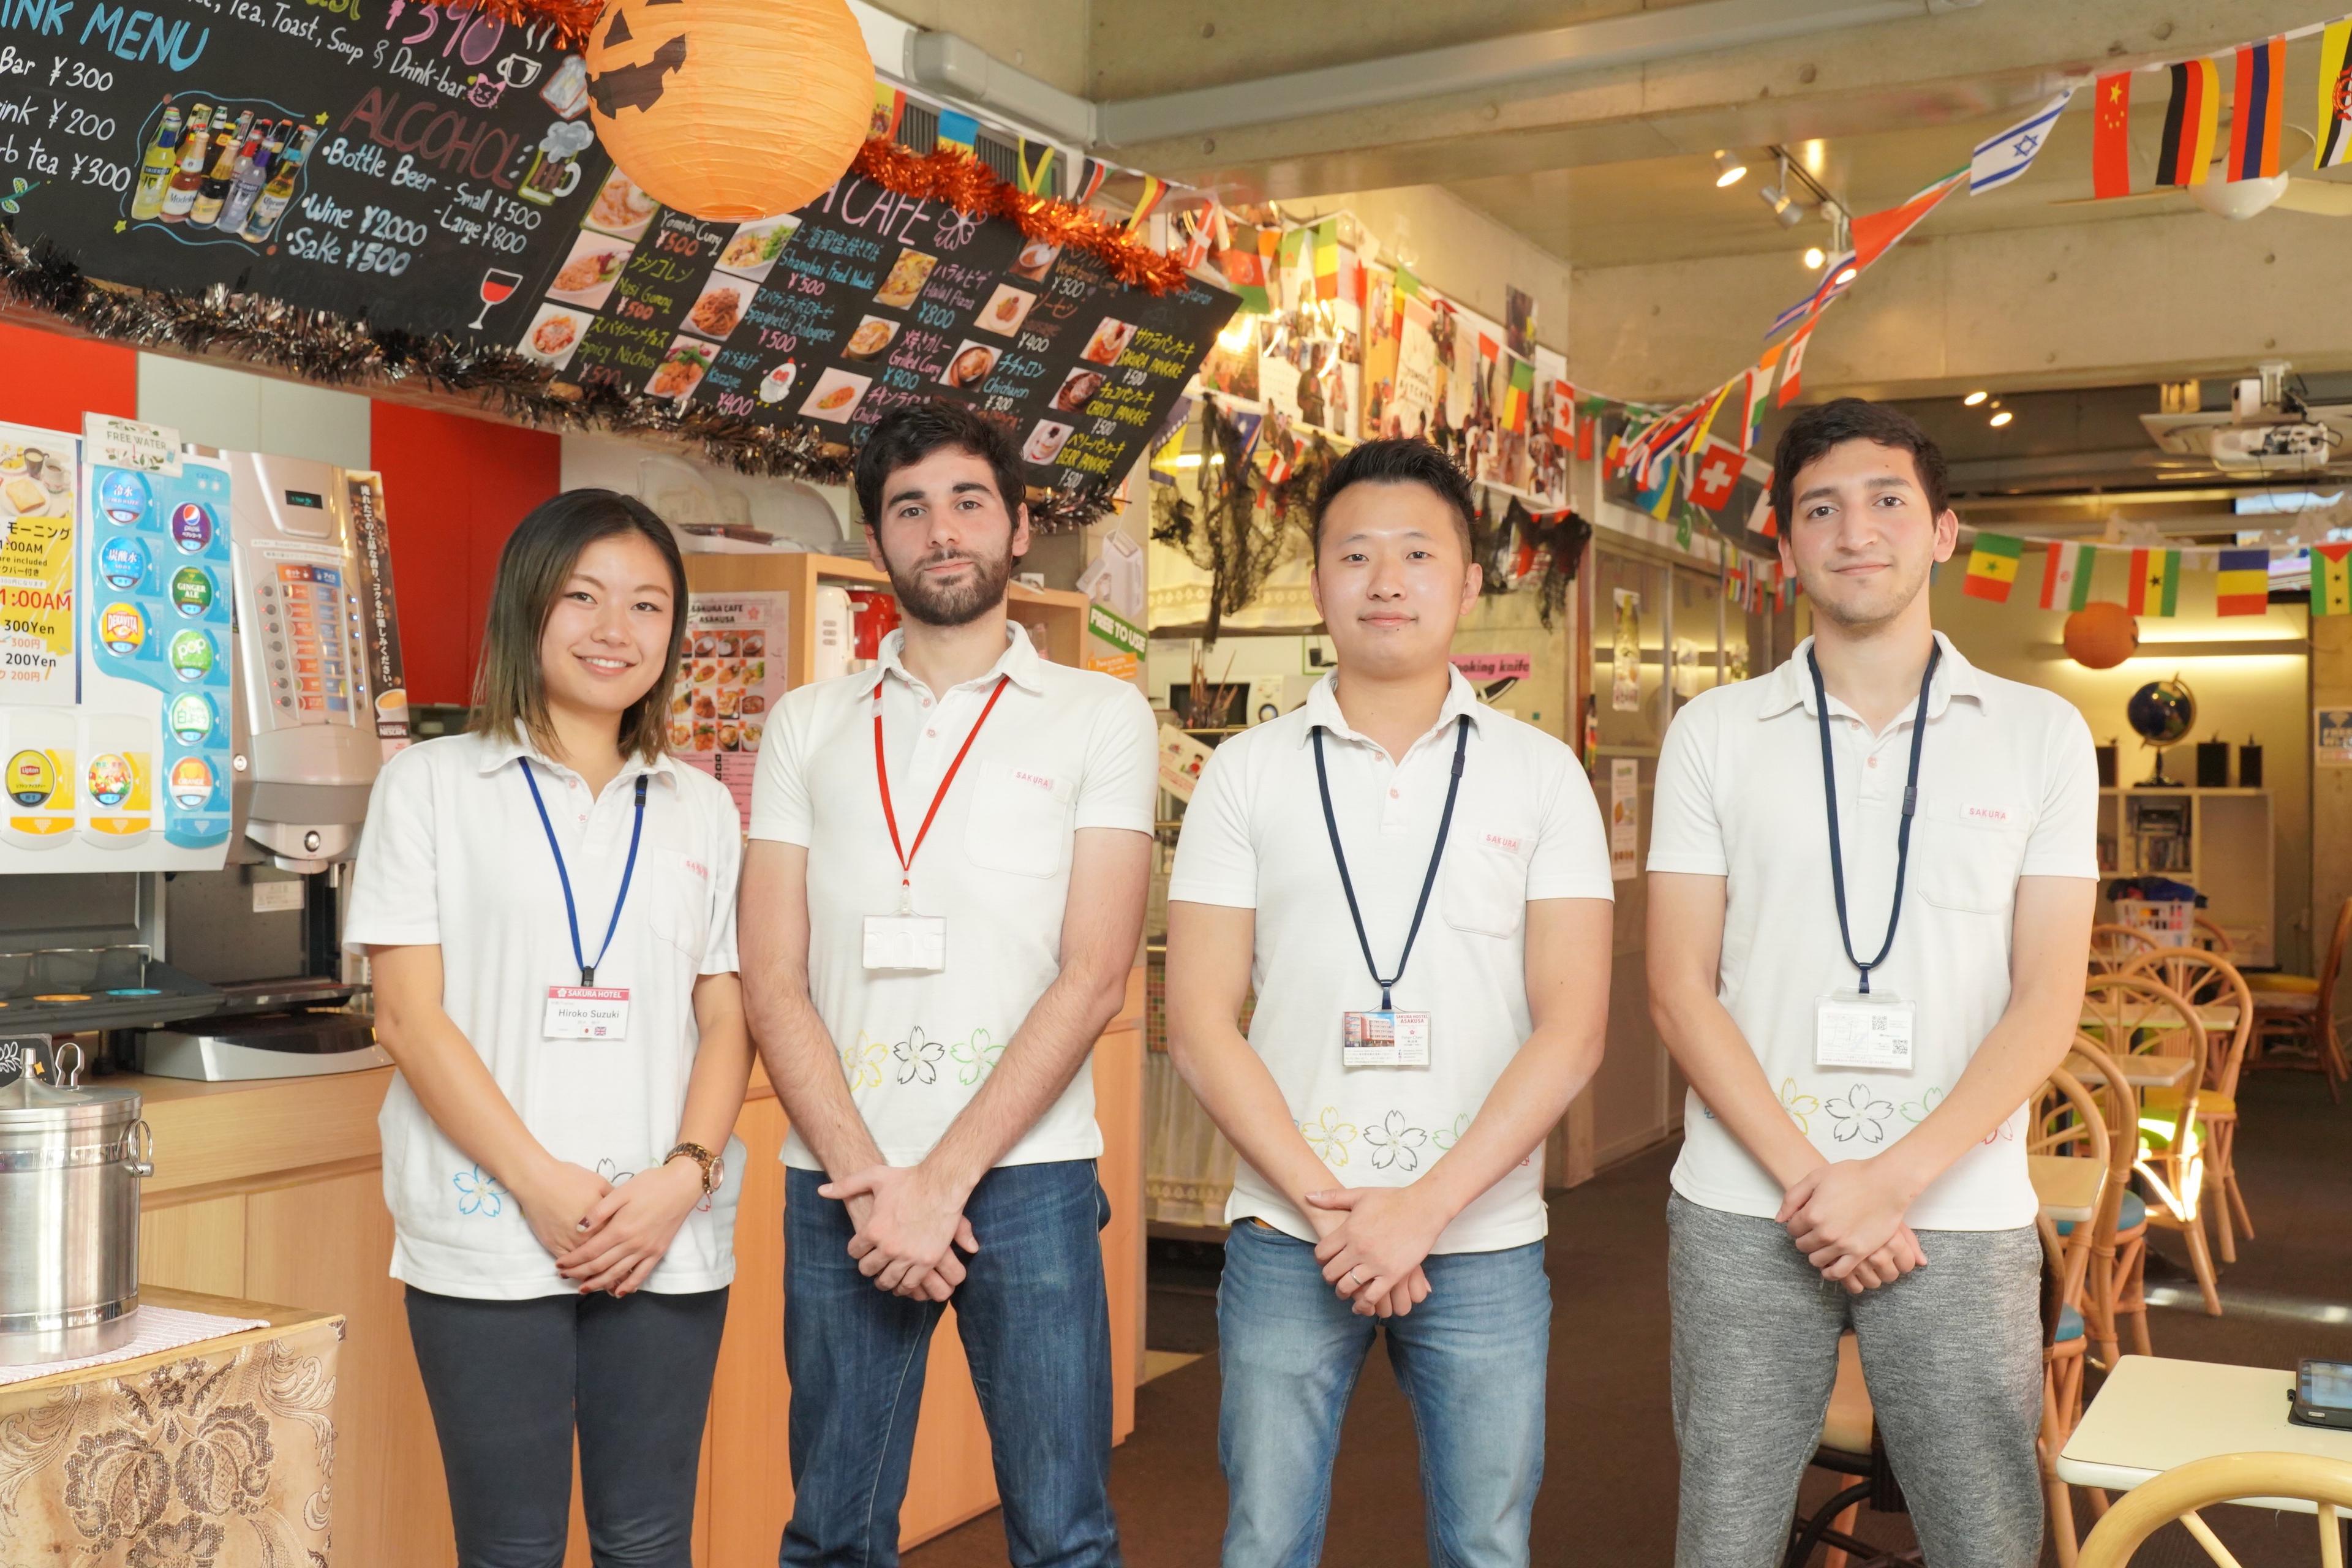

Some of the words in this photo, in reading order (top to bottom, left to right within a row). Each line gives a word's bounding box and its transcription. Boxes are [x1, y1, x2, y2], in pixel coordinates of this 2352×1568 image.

[80, 2, 209, 72] MENU
[272, 2, 322, 47] Toast,
[327, 27, 363, 65] Soup
[390, 47, 466, 98] Drink-bar
[0, 46, 36, 75] Bar
[49, 56, 113, 91] ¥300
[0, 96, 39, 125] ink
[48, 99, 115, 141] ¥200
[28, 138, 58, 175] tea
[70, 153, 131, 192] ¥300
[328, 138, 386, 178] Bottle
[391, 154, 437, 192] Beer
[493, 195, 541, 230] ¥500
[306, 193, 353, 229] Wine
[842, 179, 931, 245] CAFE
[481, 221, 527, 254] ¥800
[696, 222, 723, 257] Curry
[345, 240, 411, 277] ¥500
[788, 272, 825, 296] ¥500
[1051, 276, 1085, 298] ¥500
[918, 301, 955, 329] ¥800
[758, 328, 797, 353] ¥500
[1017, 331, 1049, 352] ¥400
[883, 366, 919, 390] ¥800
[107, 431, 132, 443] FREE
[134, 435, 167, 450] WATER
[113, 484, 132, 497] 冷水
[7, 522, 71, 540] モーニング
[14, 556, 47, 566] included
[108, 549, 137, 563] 炭酸水
[177, 582, 206, 592] GINGER
[4, 619, 55, 635] 300Yen
[1090, 608, 1114, 635] FREE
[1115, 621, 1128, 642] TO
[1128, 630, 1146, 653] USE
[12, 637, 40, 650] 300円
[177, 638, 206, 661] pop
[6, 653, 56, 667] 200Yen
[1452, 661, 1494, 674] ooking
[12, 671, 40, 682] 200円
[21, 766, 40, 775] Lipton
[1016, 772, 1048, 787] SAKURA
[1970, 808, 2006, 820] SAKURA
[1487, 834, 1517, 848] SAKURA
[559, 1009, 587, 1018] Hiroko
